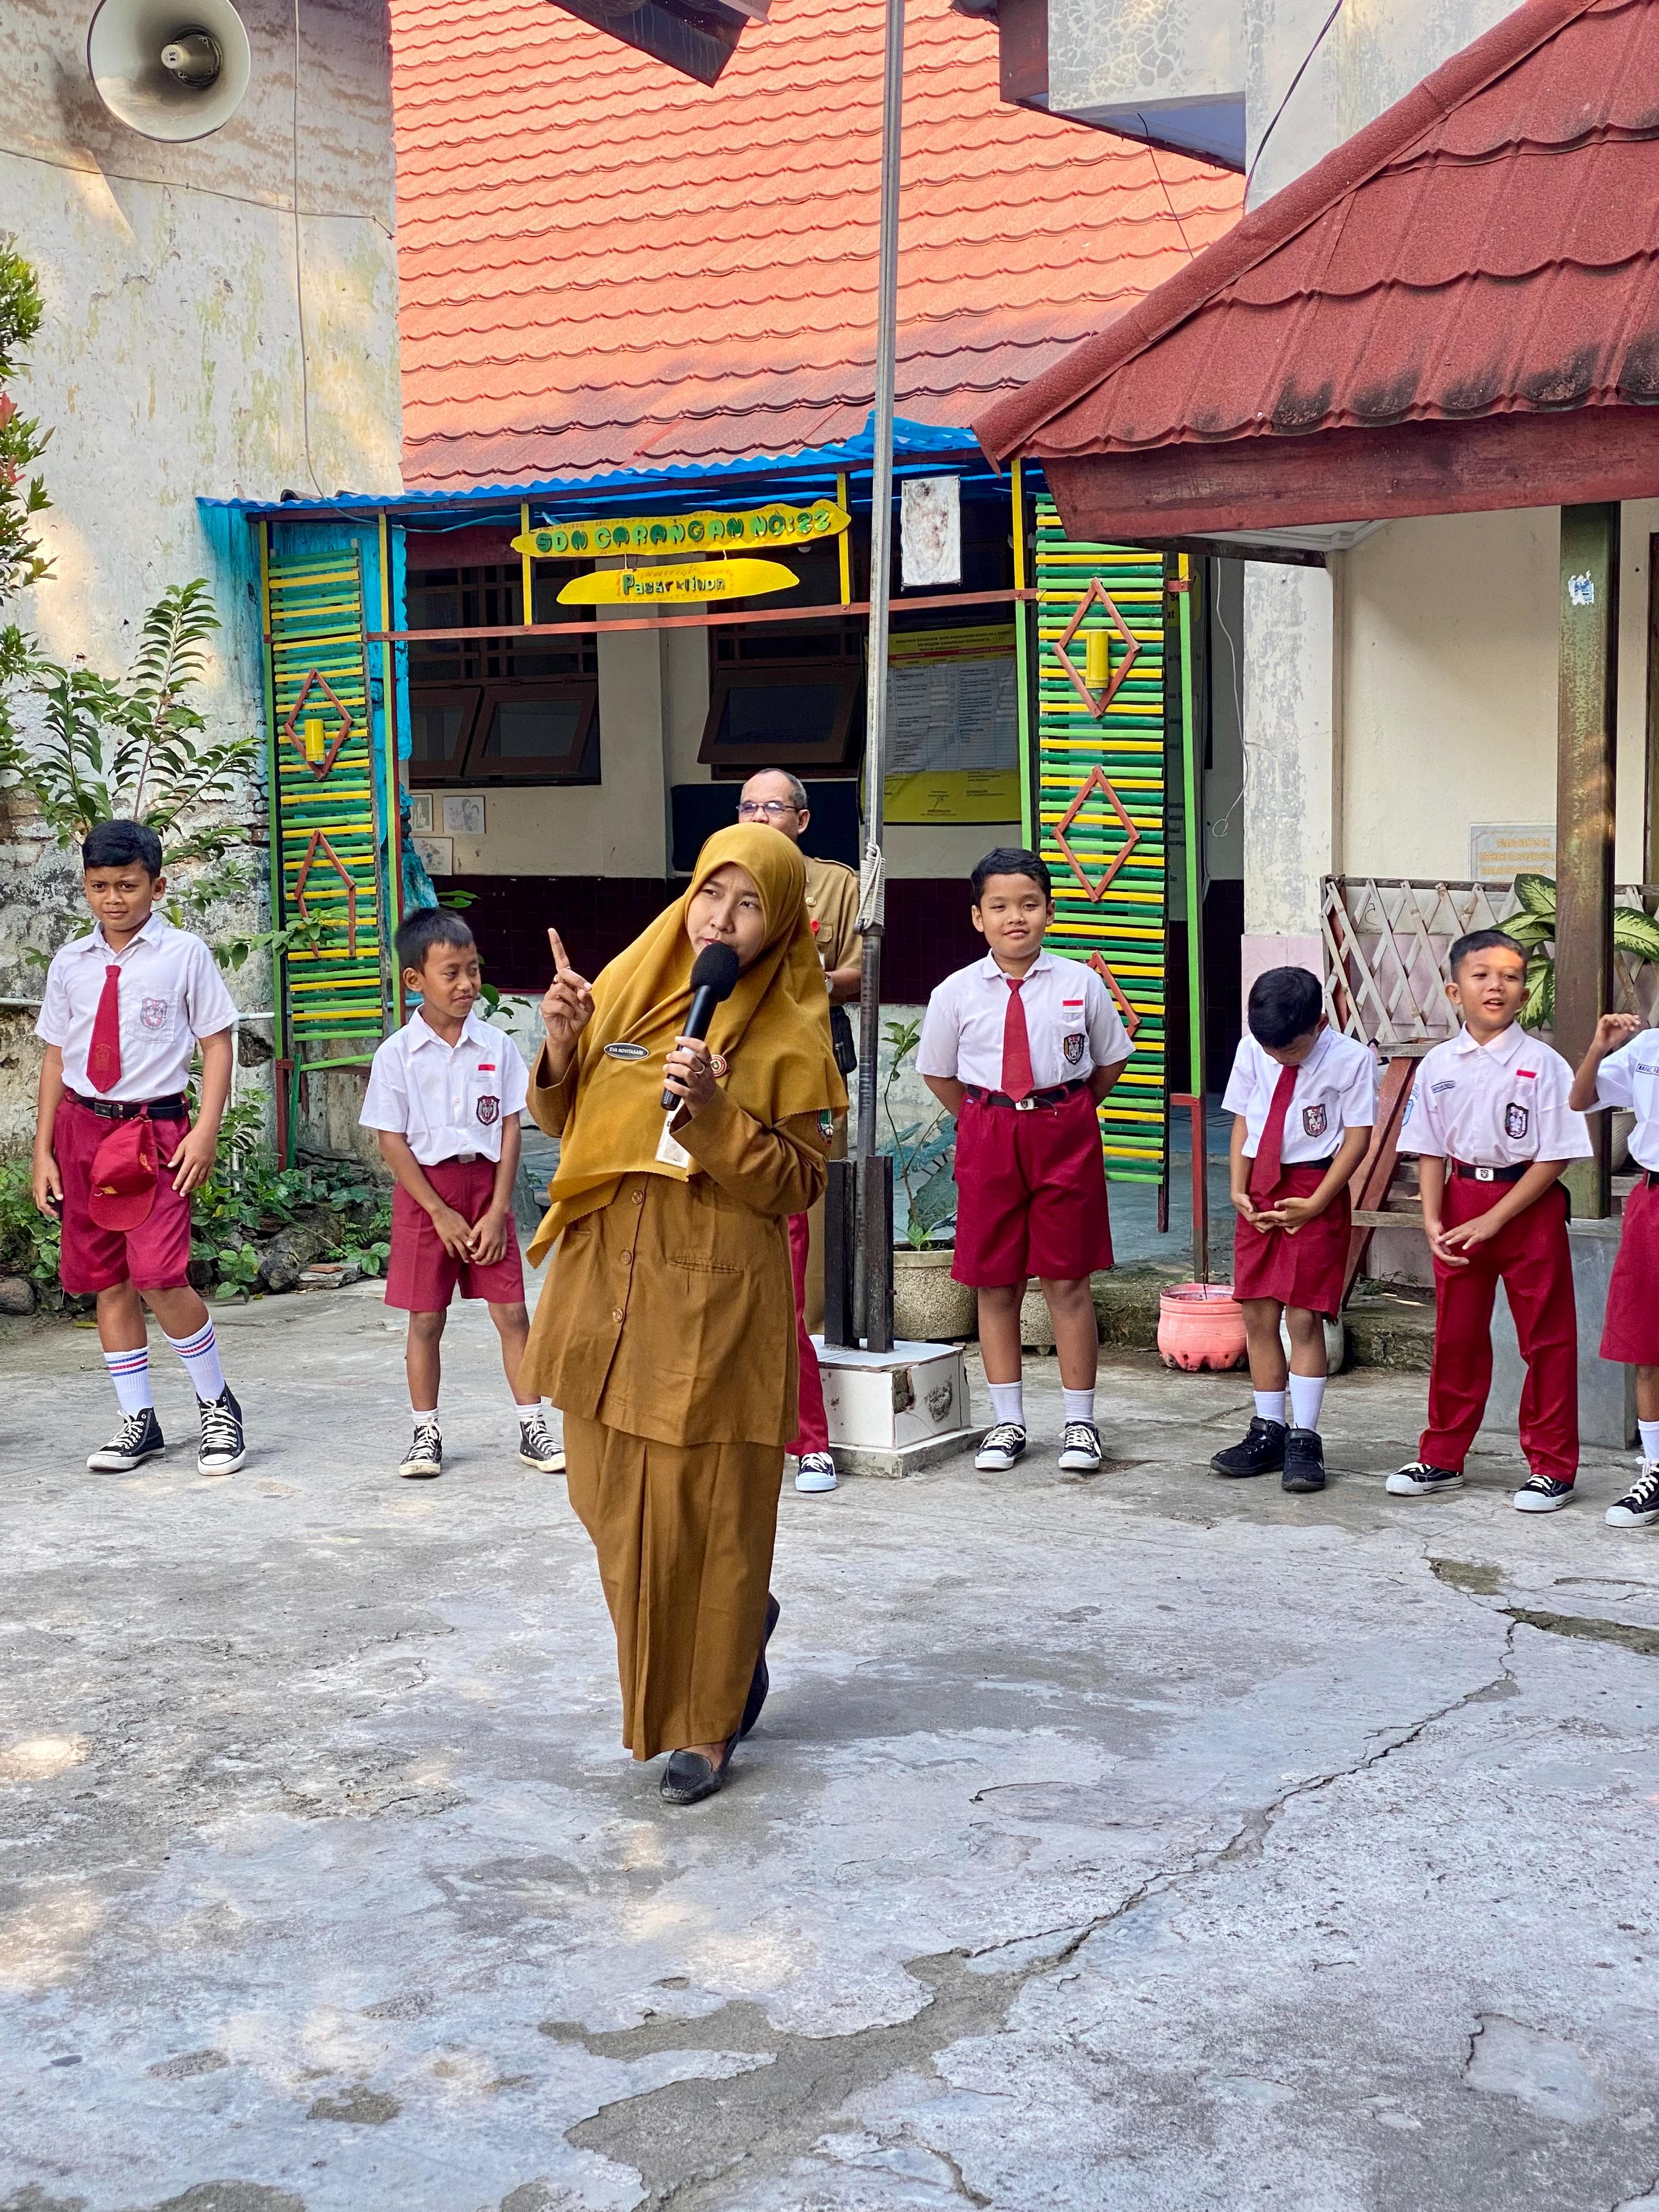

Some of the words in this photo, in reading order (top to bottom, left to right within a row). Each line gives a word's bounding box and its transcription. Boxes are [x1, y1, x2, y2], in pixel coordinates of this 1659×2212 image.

[536, 530, 588, 552] SDN
[594, 517, 743, 548] CARANGAN
[750, 508, 831, 538] NO:22
